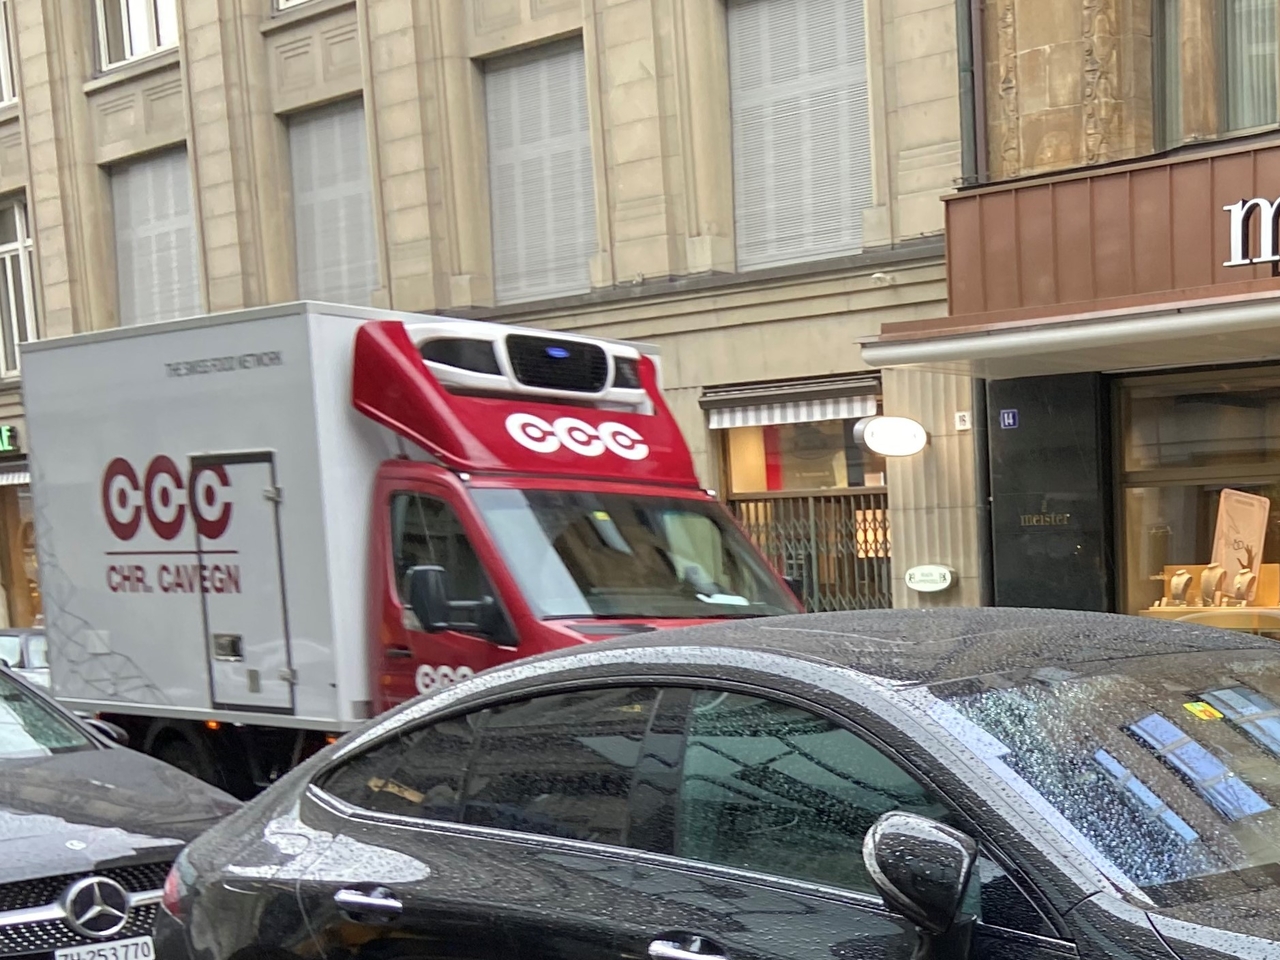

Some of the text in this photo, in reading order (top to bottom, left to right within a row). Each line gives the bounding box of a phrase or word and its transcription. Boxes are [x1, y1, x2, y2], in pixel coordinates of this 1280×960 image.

[1003, 412, 1014, 426] 14
[504, 412, 650, 461] CCC
[102, 453, 232, 542] CCC
[1020, 512, 1071, 526] meister
[106, 563, 242, 594] CHR. CAVEGN
